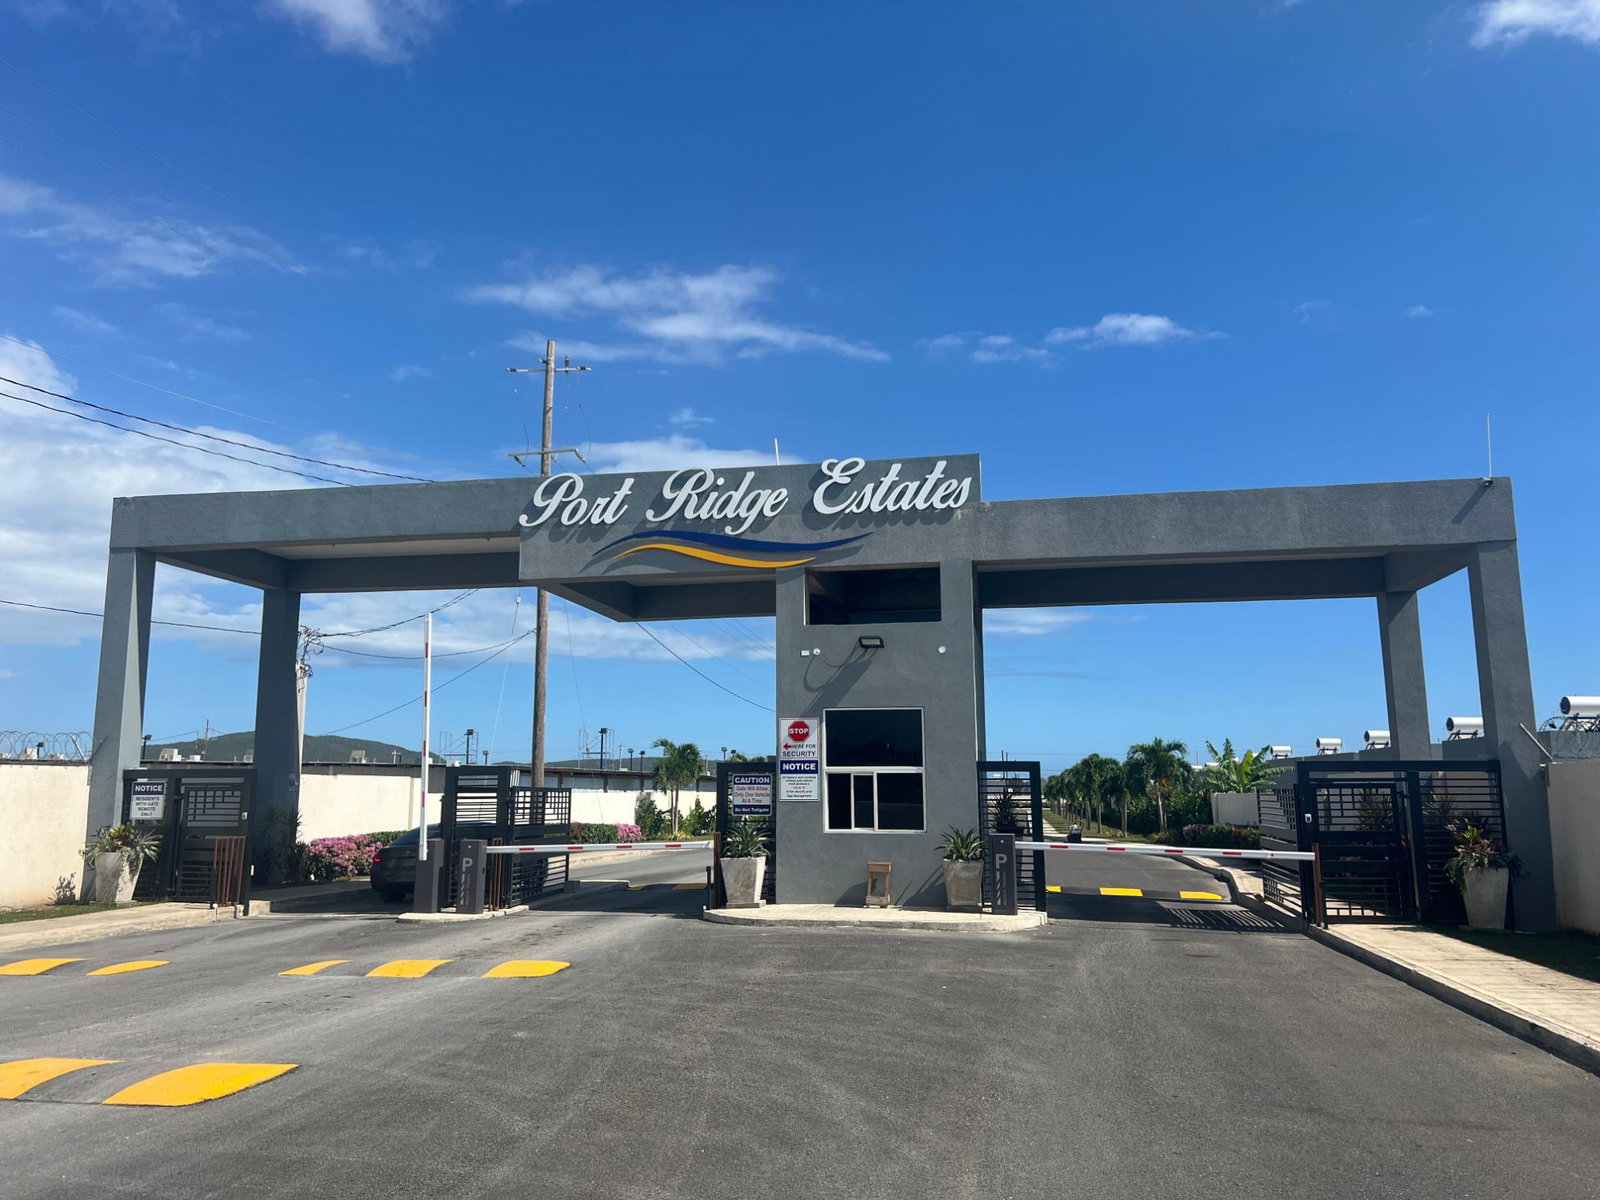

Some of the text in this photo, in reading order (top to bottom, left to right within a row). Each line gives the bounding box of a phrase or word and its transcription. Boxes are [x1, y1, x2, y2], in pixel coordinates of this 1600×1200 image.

[519, 457, 973, 535] Port Ridge Estates
[463, 857, 473, 872] P
[995, 853, 1007, 869] P
